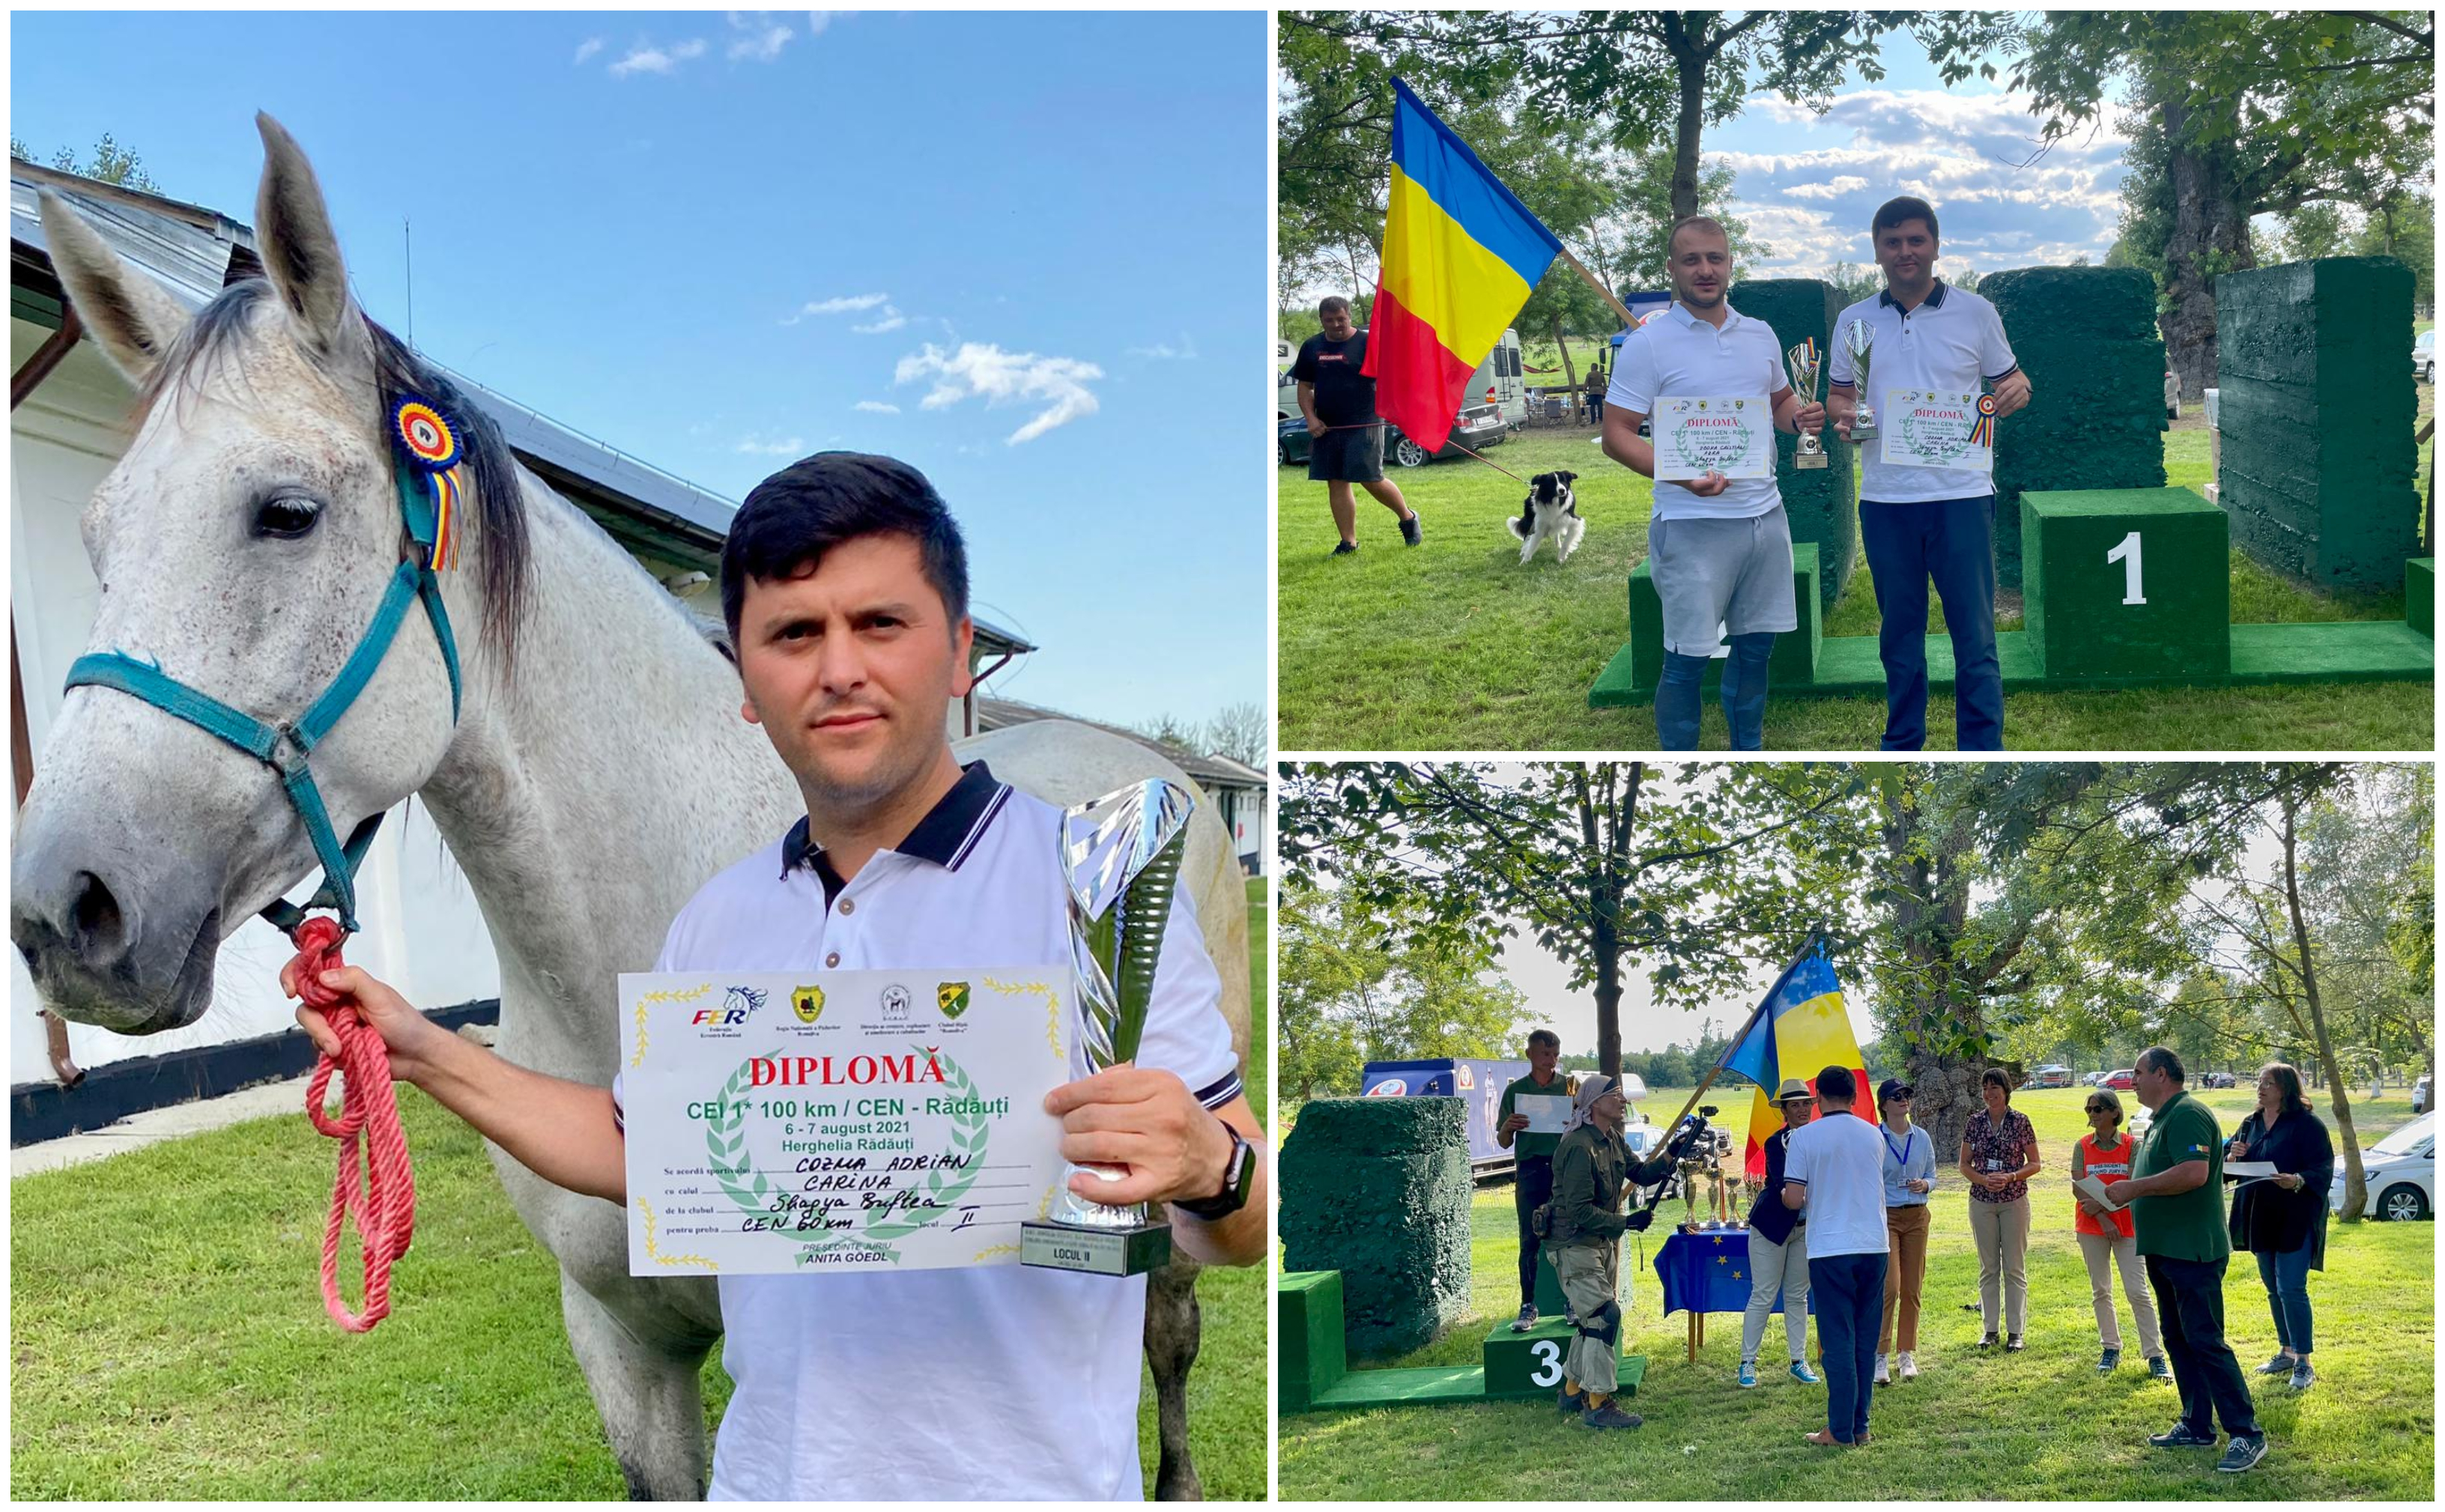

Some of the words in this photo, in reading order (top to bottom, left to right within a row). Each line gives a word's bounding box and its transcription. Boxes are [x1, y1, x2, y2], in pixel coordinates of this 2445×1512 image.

[2107, 531, 2147, 605] 1
[692, 1009, 746, 1024] FER
[749, 1046, 947, 1087] DIPLOMĂ
[687, 1102, 724, 1120] CEI
[760, 1100, 797, 1118] 100
[805, 1100, 837, 1117] km
[843, 1099, 850, 1117] /
[857, 1099, 903, 1116] CEN
[926, 1096, 1010, 1120] Rădăuți
[785, 1123, 794, 1135] 6
[808, 1123, 815, 1135] 7
[820, 1122, 873, 1138] august
[876, 1121, 910, 1134] 2021
[782, 1139, 853, 1154] Herghelia
[858, 1137, 914, 1153] Rădăuți
[664, 1168, 673, 1176] Se
[796, 1157, 867, 1174] COZMA
[678, 1187, 698, 1195] calul
[678, 1206, 685, 1215] la
[688, 1206, 714, 1215] clubul
[666, 1227, 694, 1236] pentru
[742, 1216, 788, 1233] CEN
[805, 1253, 842, 1264] ANITA
[1054, 1248, 1081, 1261] LOCUL
[1530, 1340, 1563, 1388] 3
